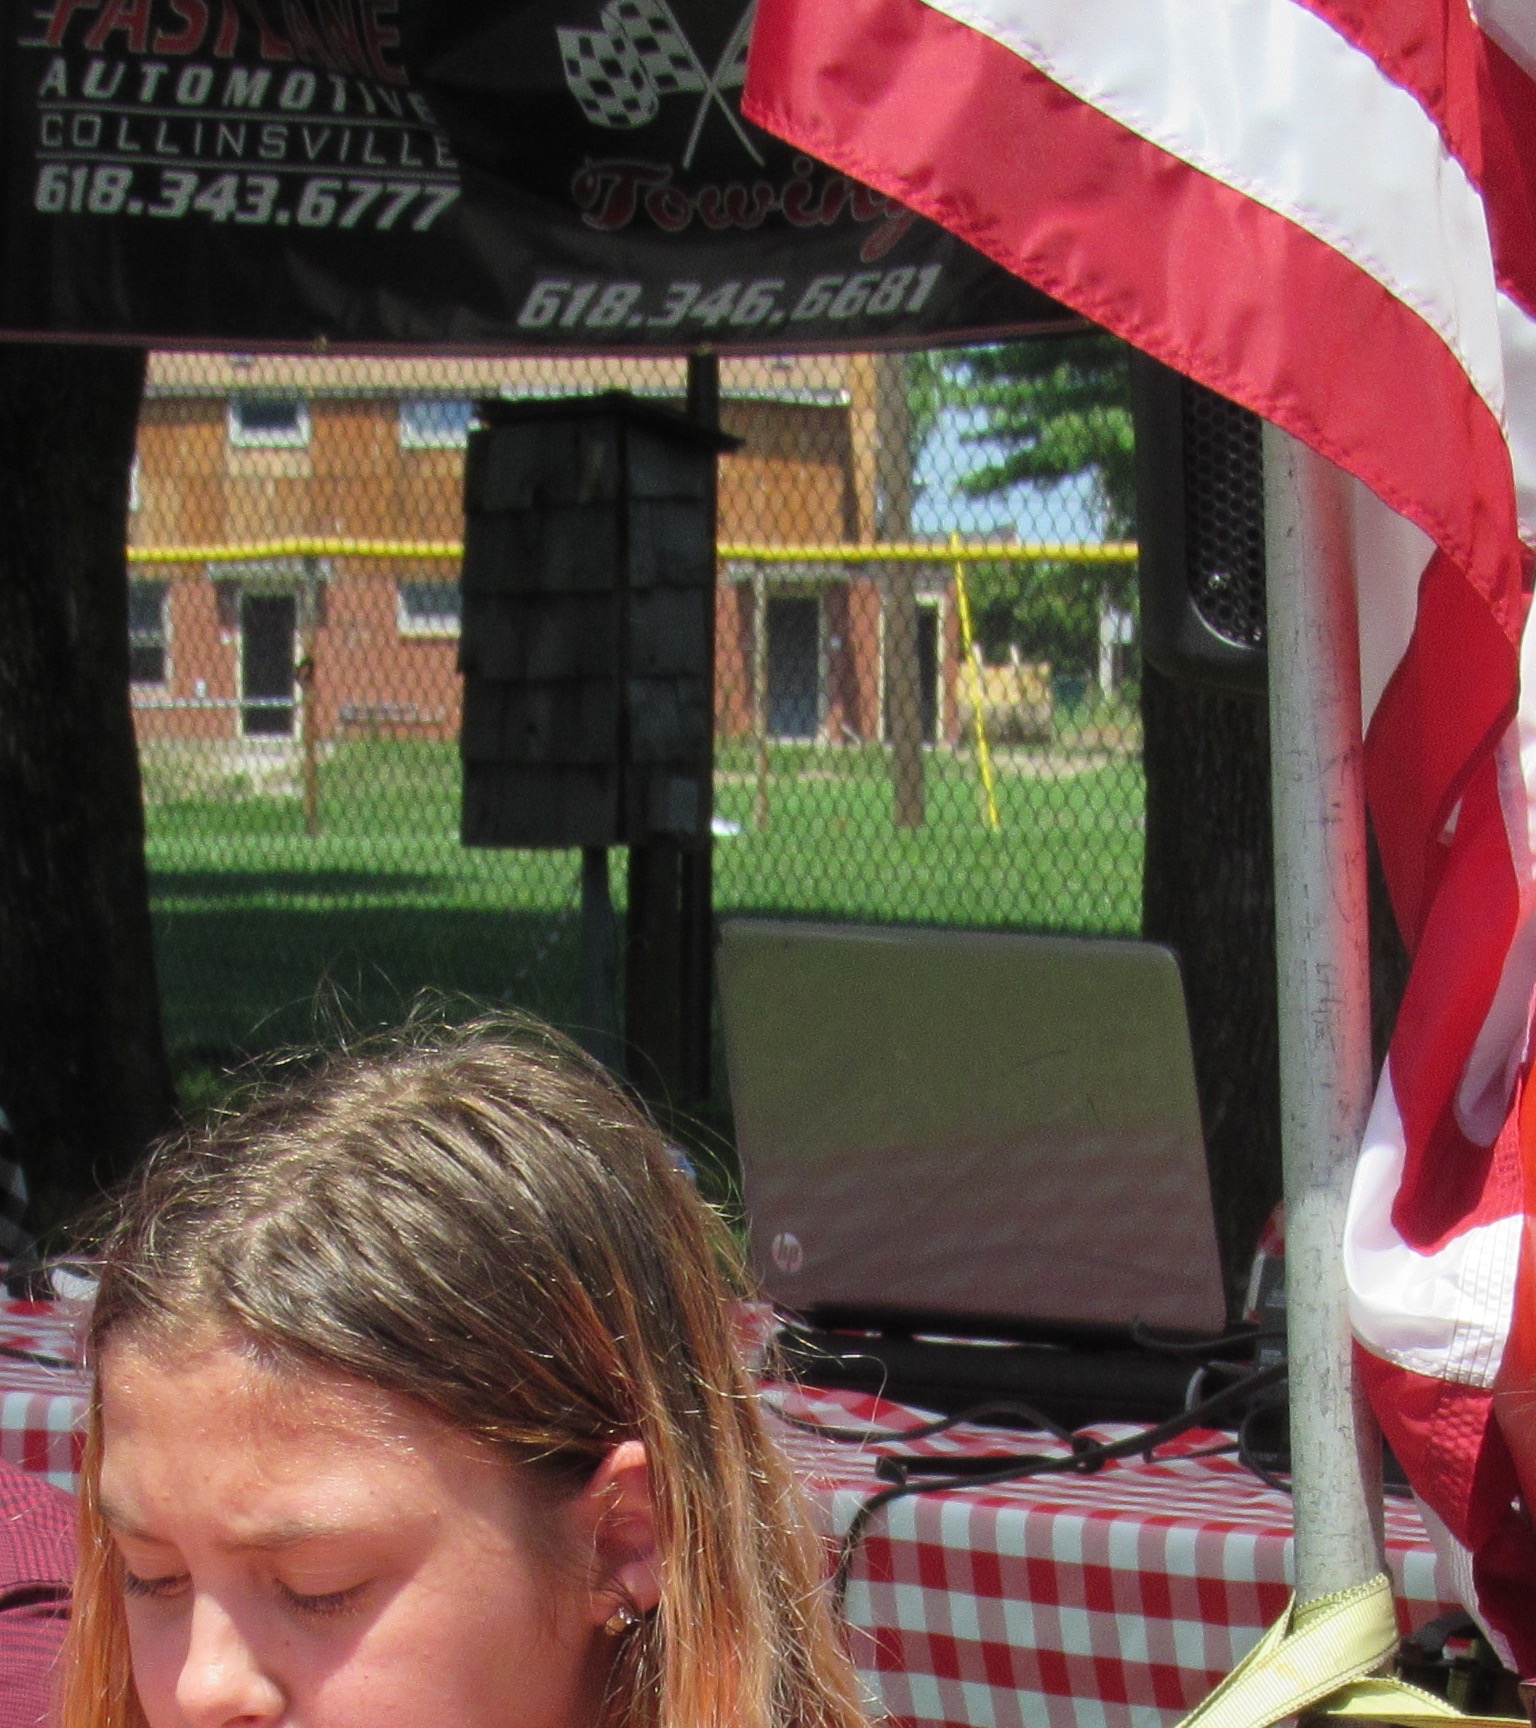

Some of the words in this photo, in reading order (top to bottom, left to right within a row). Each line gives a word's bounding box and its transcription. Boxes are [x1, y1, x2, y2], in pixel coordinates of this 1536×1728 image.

[38, 56, 438, 125] AUTOMOTIVE
[40, 113, 459, 169] COLLINSVILLE
[34, 163, 462, 232] 618.343.6777
